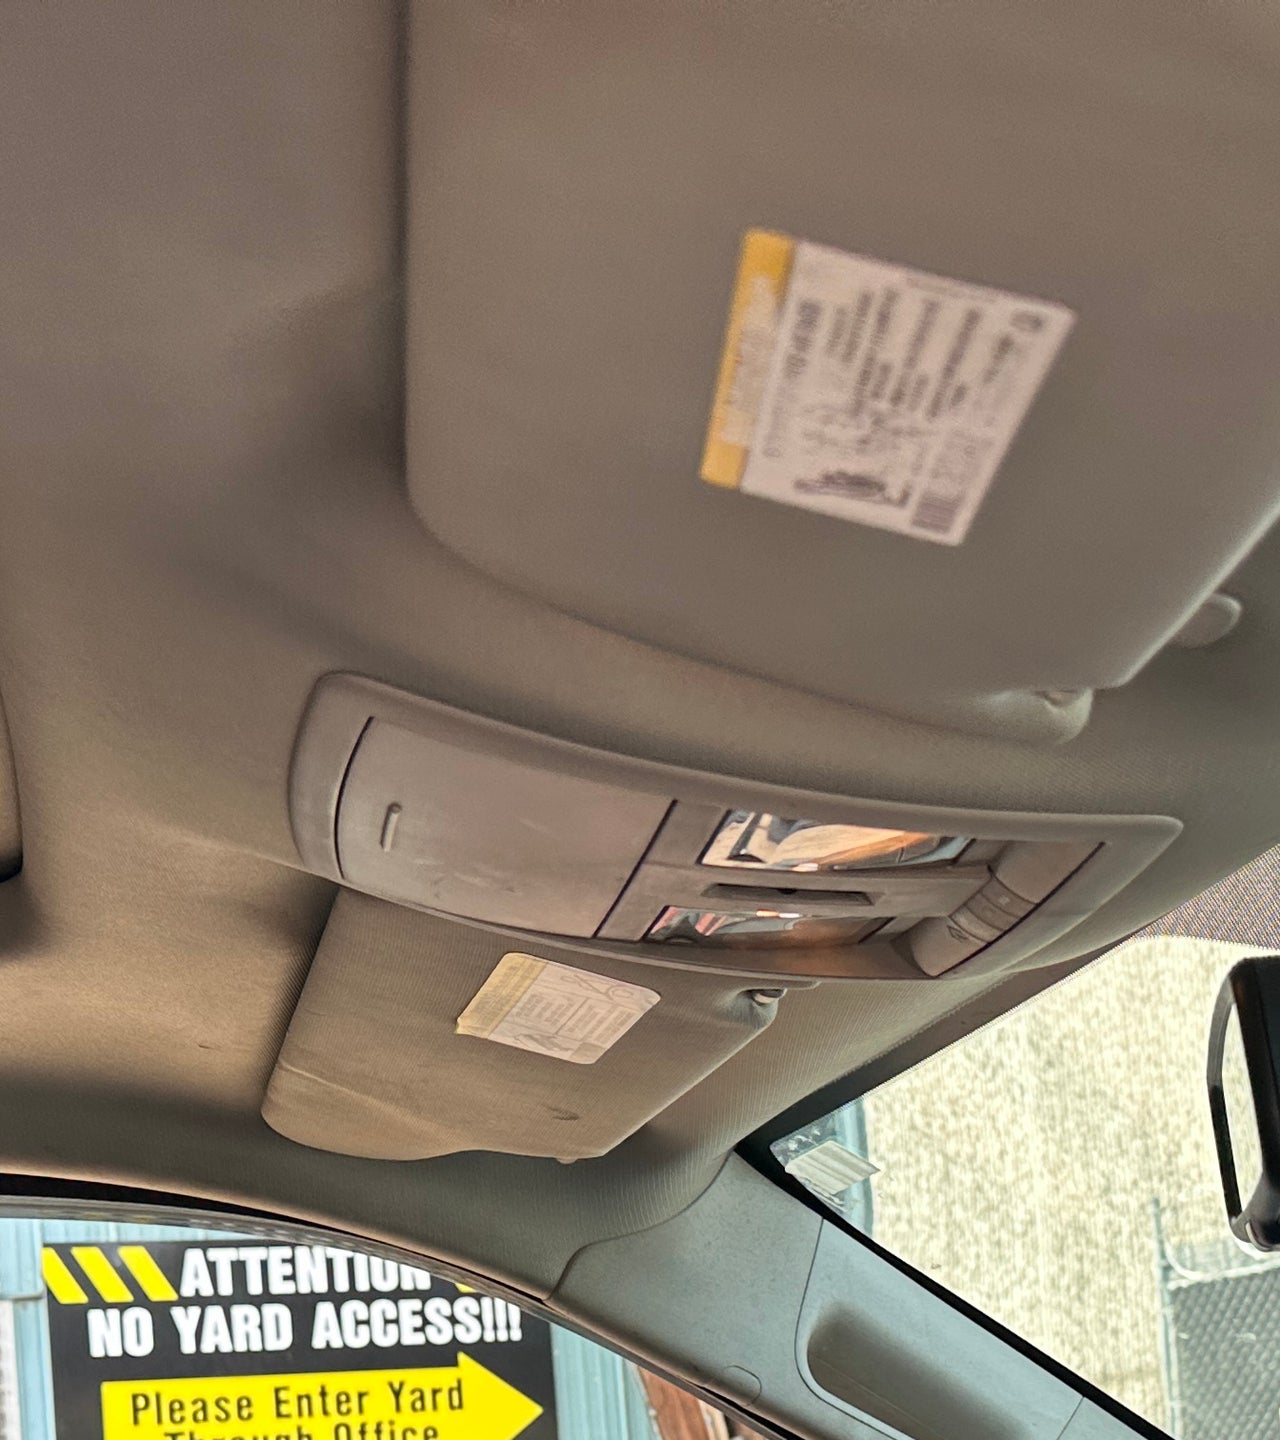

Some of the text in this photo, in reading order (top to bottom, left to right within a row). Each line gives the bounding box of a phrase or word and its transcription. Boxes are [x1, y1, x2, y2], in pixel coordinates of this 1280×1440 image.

[180, 1246, 431, 1298] ATTENTION
[87, 1297, 522, 1358] NO YARD ACCESS!!!
[132, 1379, 465, 1426] Please Enter Yard
